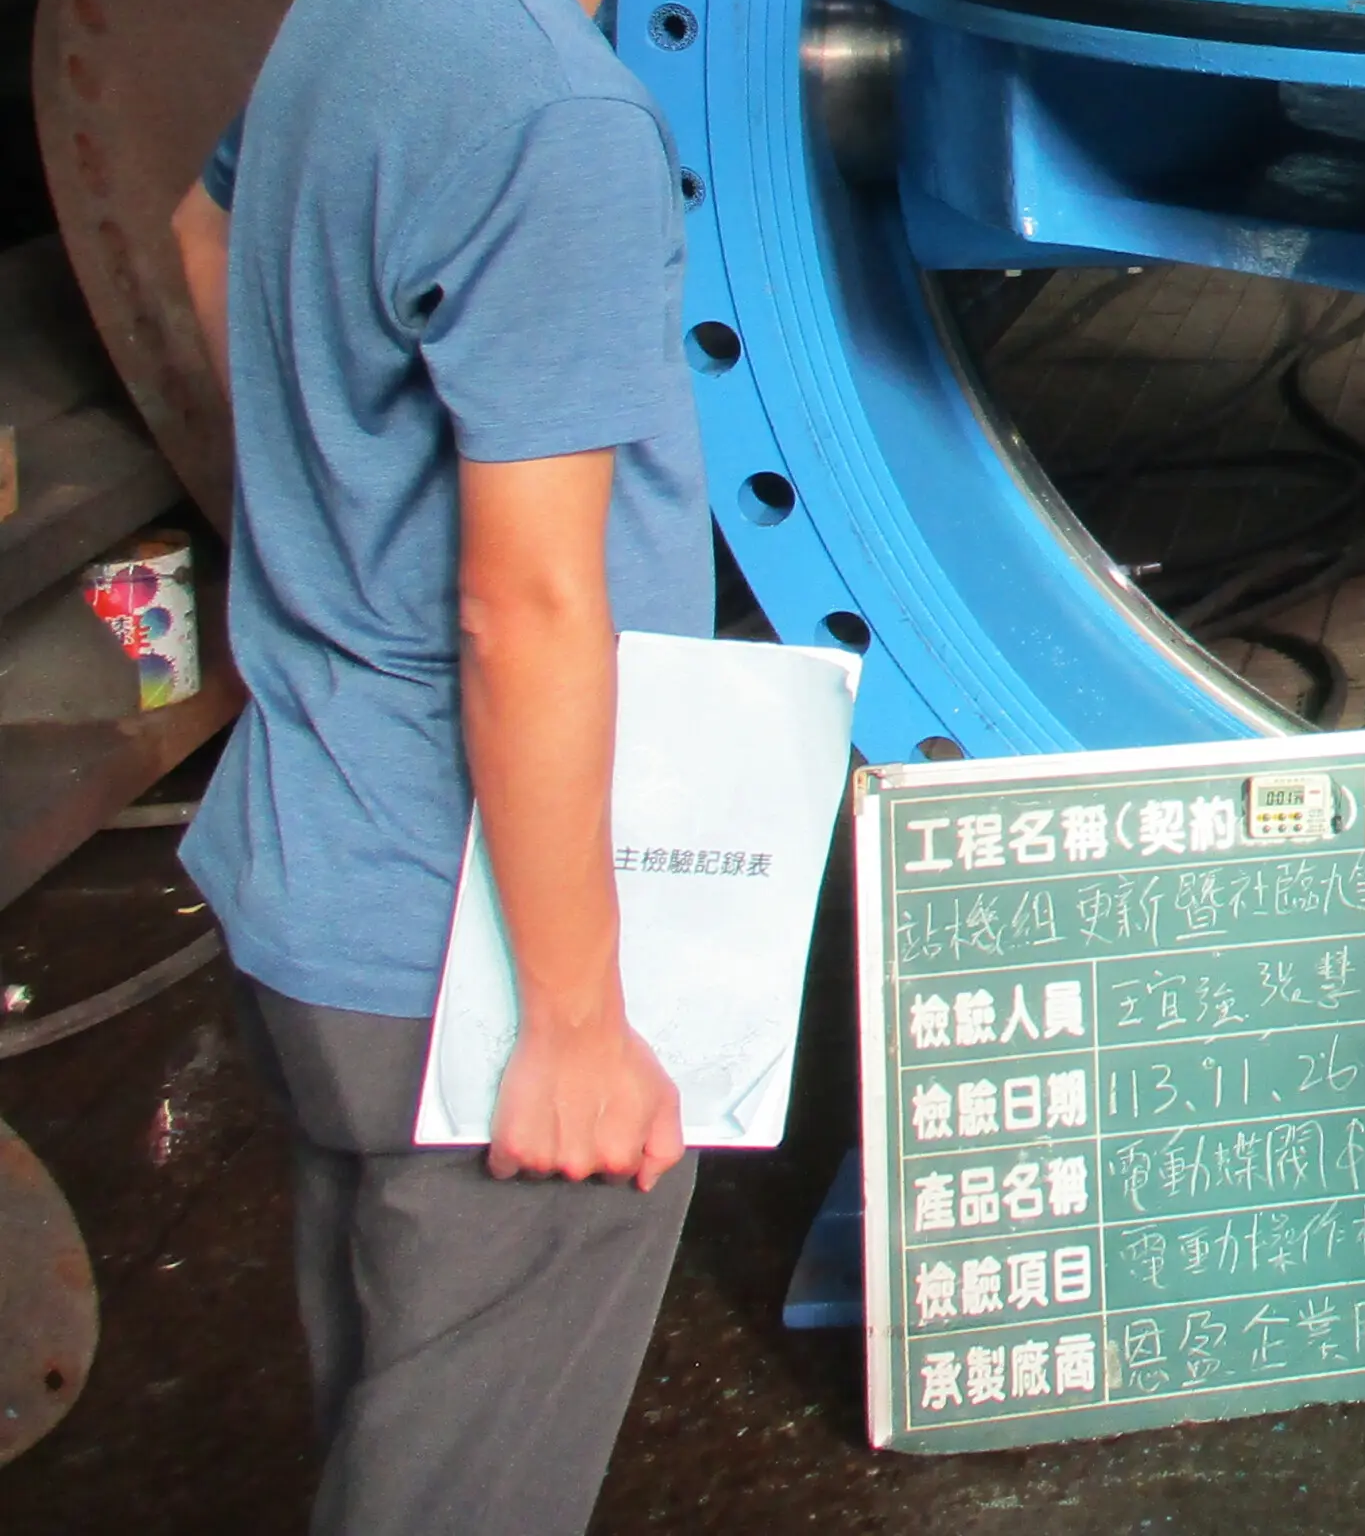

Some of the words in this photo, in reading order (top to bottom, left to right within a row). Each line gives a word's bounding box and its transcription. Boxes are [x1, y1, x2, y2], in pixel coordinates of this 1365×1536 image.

[613, 845, 773, 878] 主檢驗記錄表
[905, 784, 1358, 872] 工程名稱(契約)
[910, 979, 1086, 1049] 檢驗人員
[912, 1069, 1087, 1141] 檢驗日期
[913, 1155, 1089, 1233] 產品名稱
[915, 1244, 1092, 1322] 檢驗項目
[920, 1332, 1097, 1410] 承製廠商
